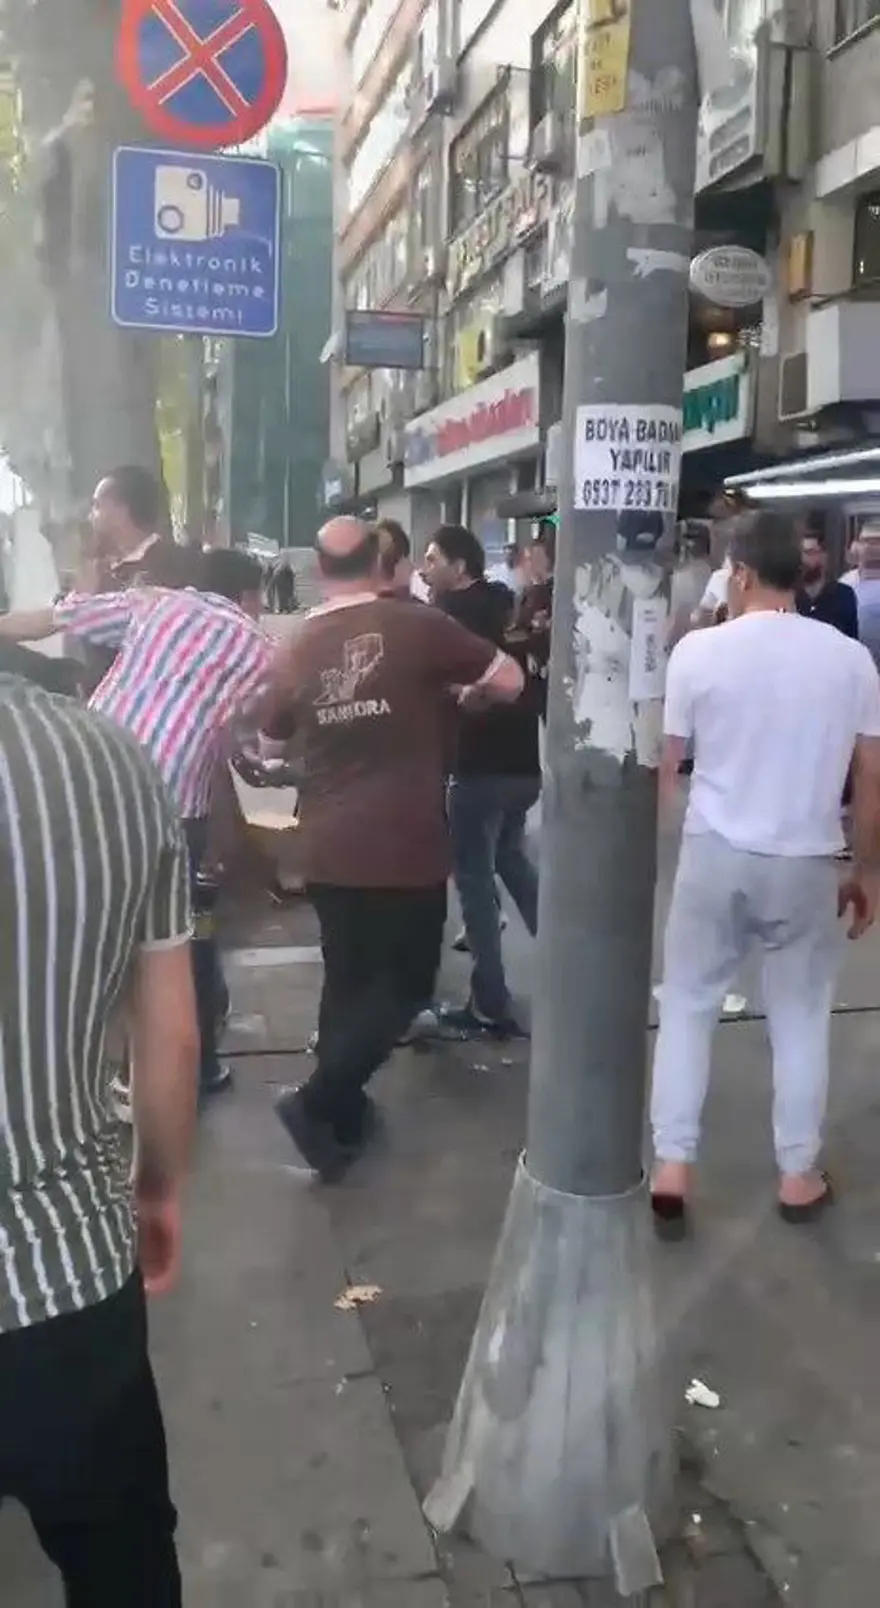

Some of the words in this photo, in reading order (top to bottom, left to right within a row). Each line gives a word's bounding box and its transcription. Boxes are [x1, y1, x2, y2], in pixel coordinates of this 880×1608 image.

[128, 245, 263, 273] Elektronik
[124, 268, 265, 299] Denetleme
[144, 296, 243, 325] Sistemi
[585, 417, 631, 444] BOYA
[583, 479, 621, 506] 0537
